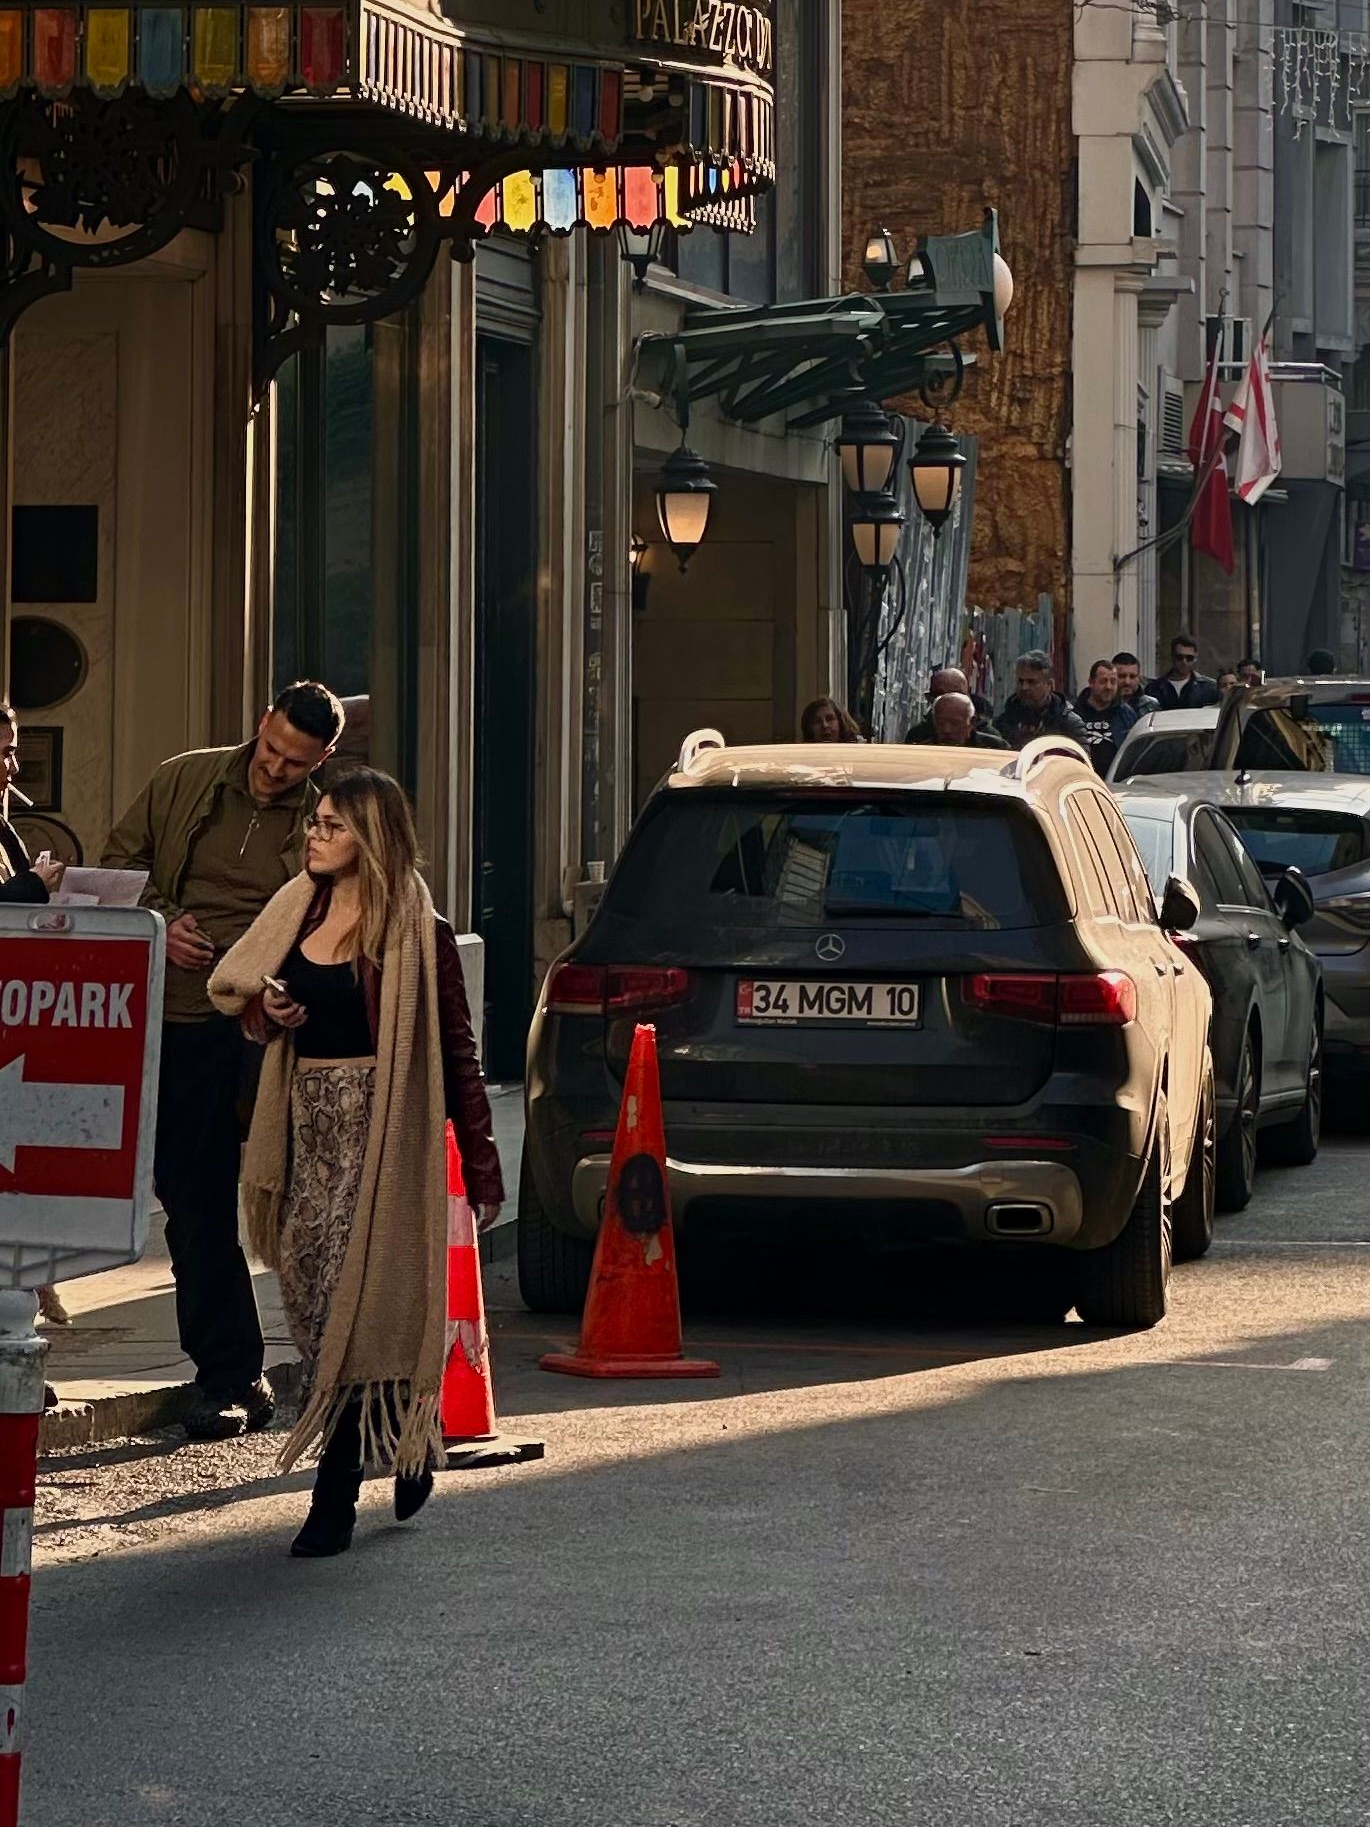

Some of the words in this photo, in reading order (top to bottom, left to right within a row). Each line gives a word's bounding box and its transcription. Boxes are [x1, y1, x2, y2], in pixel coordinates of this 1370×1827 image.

[0, 979, 135, 1029] OPARK
[754, 984, 789, 1014] 34
[798, 984, 873, 1016] MGM
[886, 986, 915, 1016] 10
